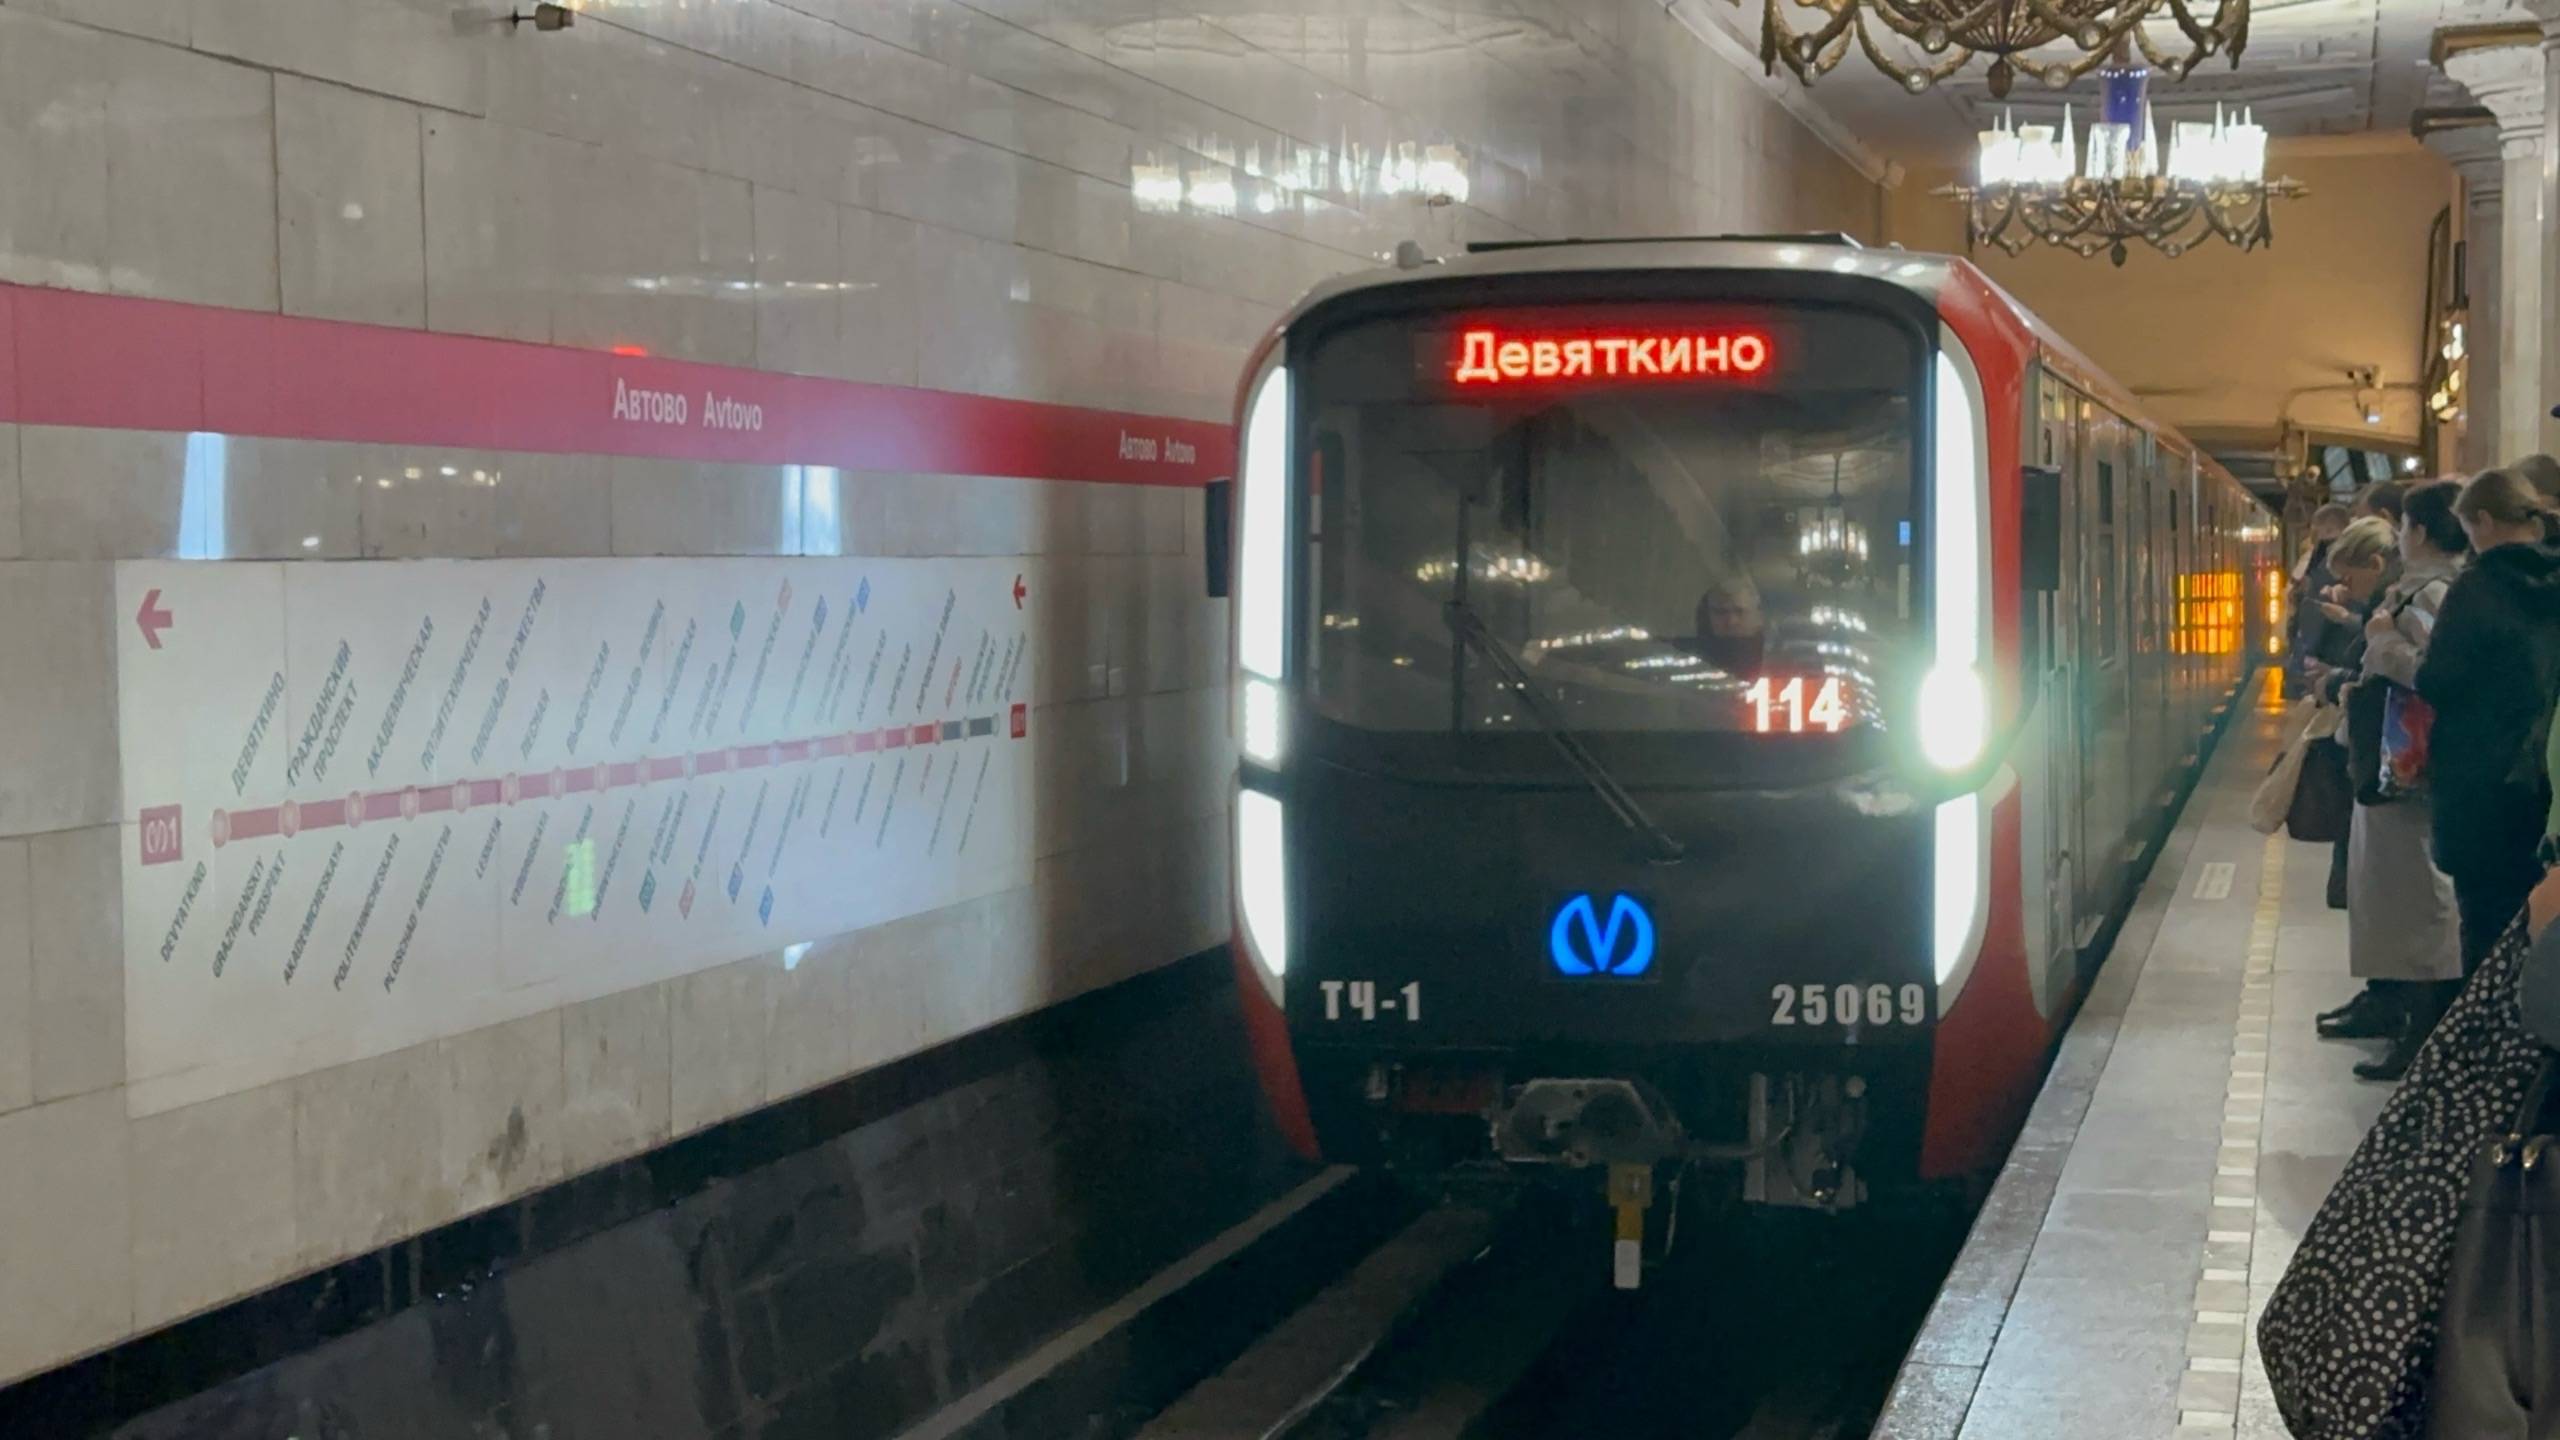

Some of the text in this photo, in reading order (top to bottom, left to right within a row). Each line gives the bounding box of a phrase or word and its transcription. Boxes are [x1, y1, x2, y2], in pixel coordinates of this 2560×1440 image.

[1456, 331, 1765, 383] Девяткино
[703, 391, 762, 431] Avtovo
[232, 672, 285, 796] ДЕВЯТКИНО
[313, 679, 359, 782] ПРОСПЕКТ
[367, 616, 433, 778] АКАДЕМИЧЕСКАЯ
[1746, 677, 1847, 733] 114
[160, 861, 206, 962] DEVYATKINO
[212, 856, 264, 978] GRAZHDANSKIY
[249, 850, 285, 936] PROSPEKT
[284, 841, 344, 985] AKADEMICHESKAYA
[1320, 981, 1421, 1021] ТЧ-1
[1771, 983, 1926, 1026] 25069
